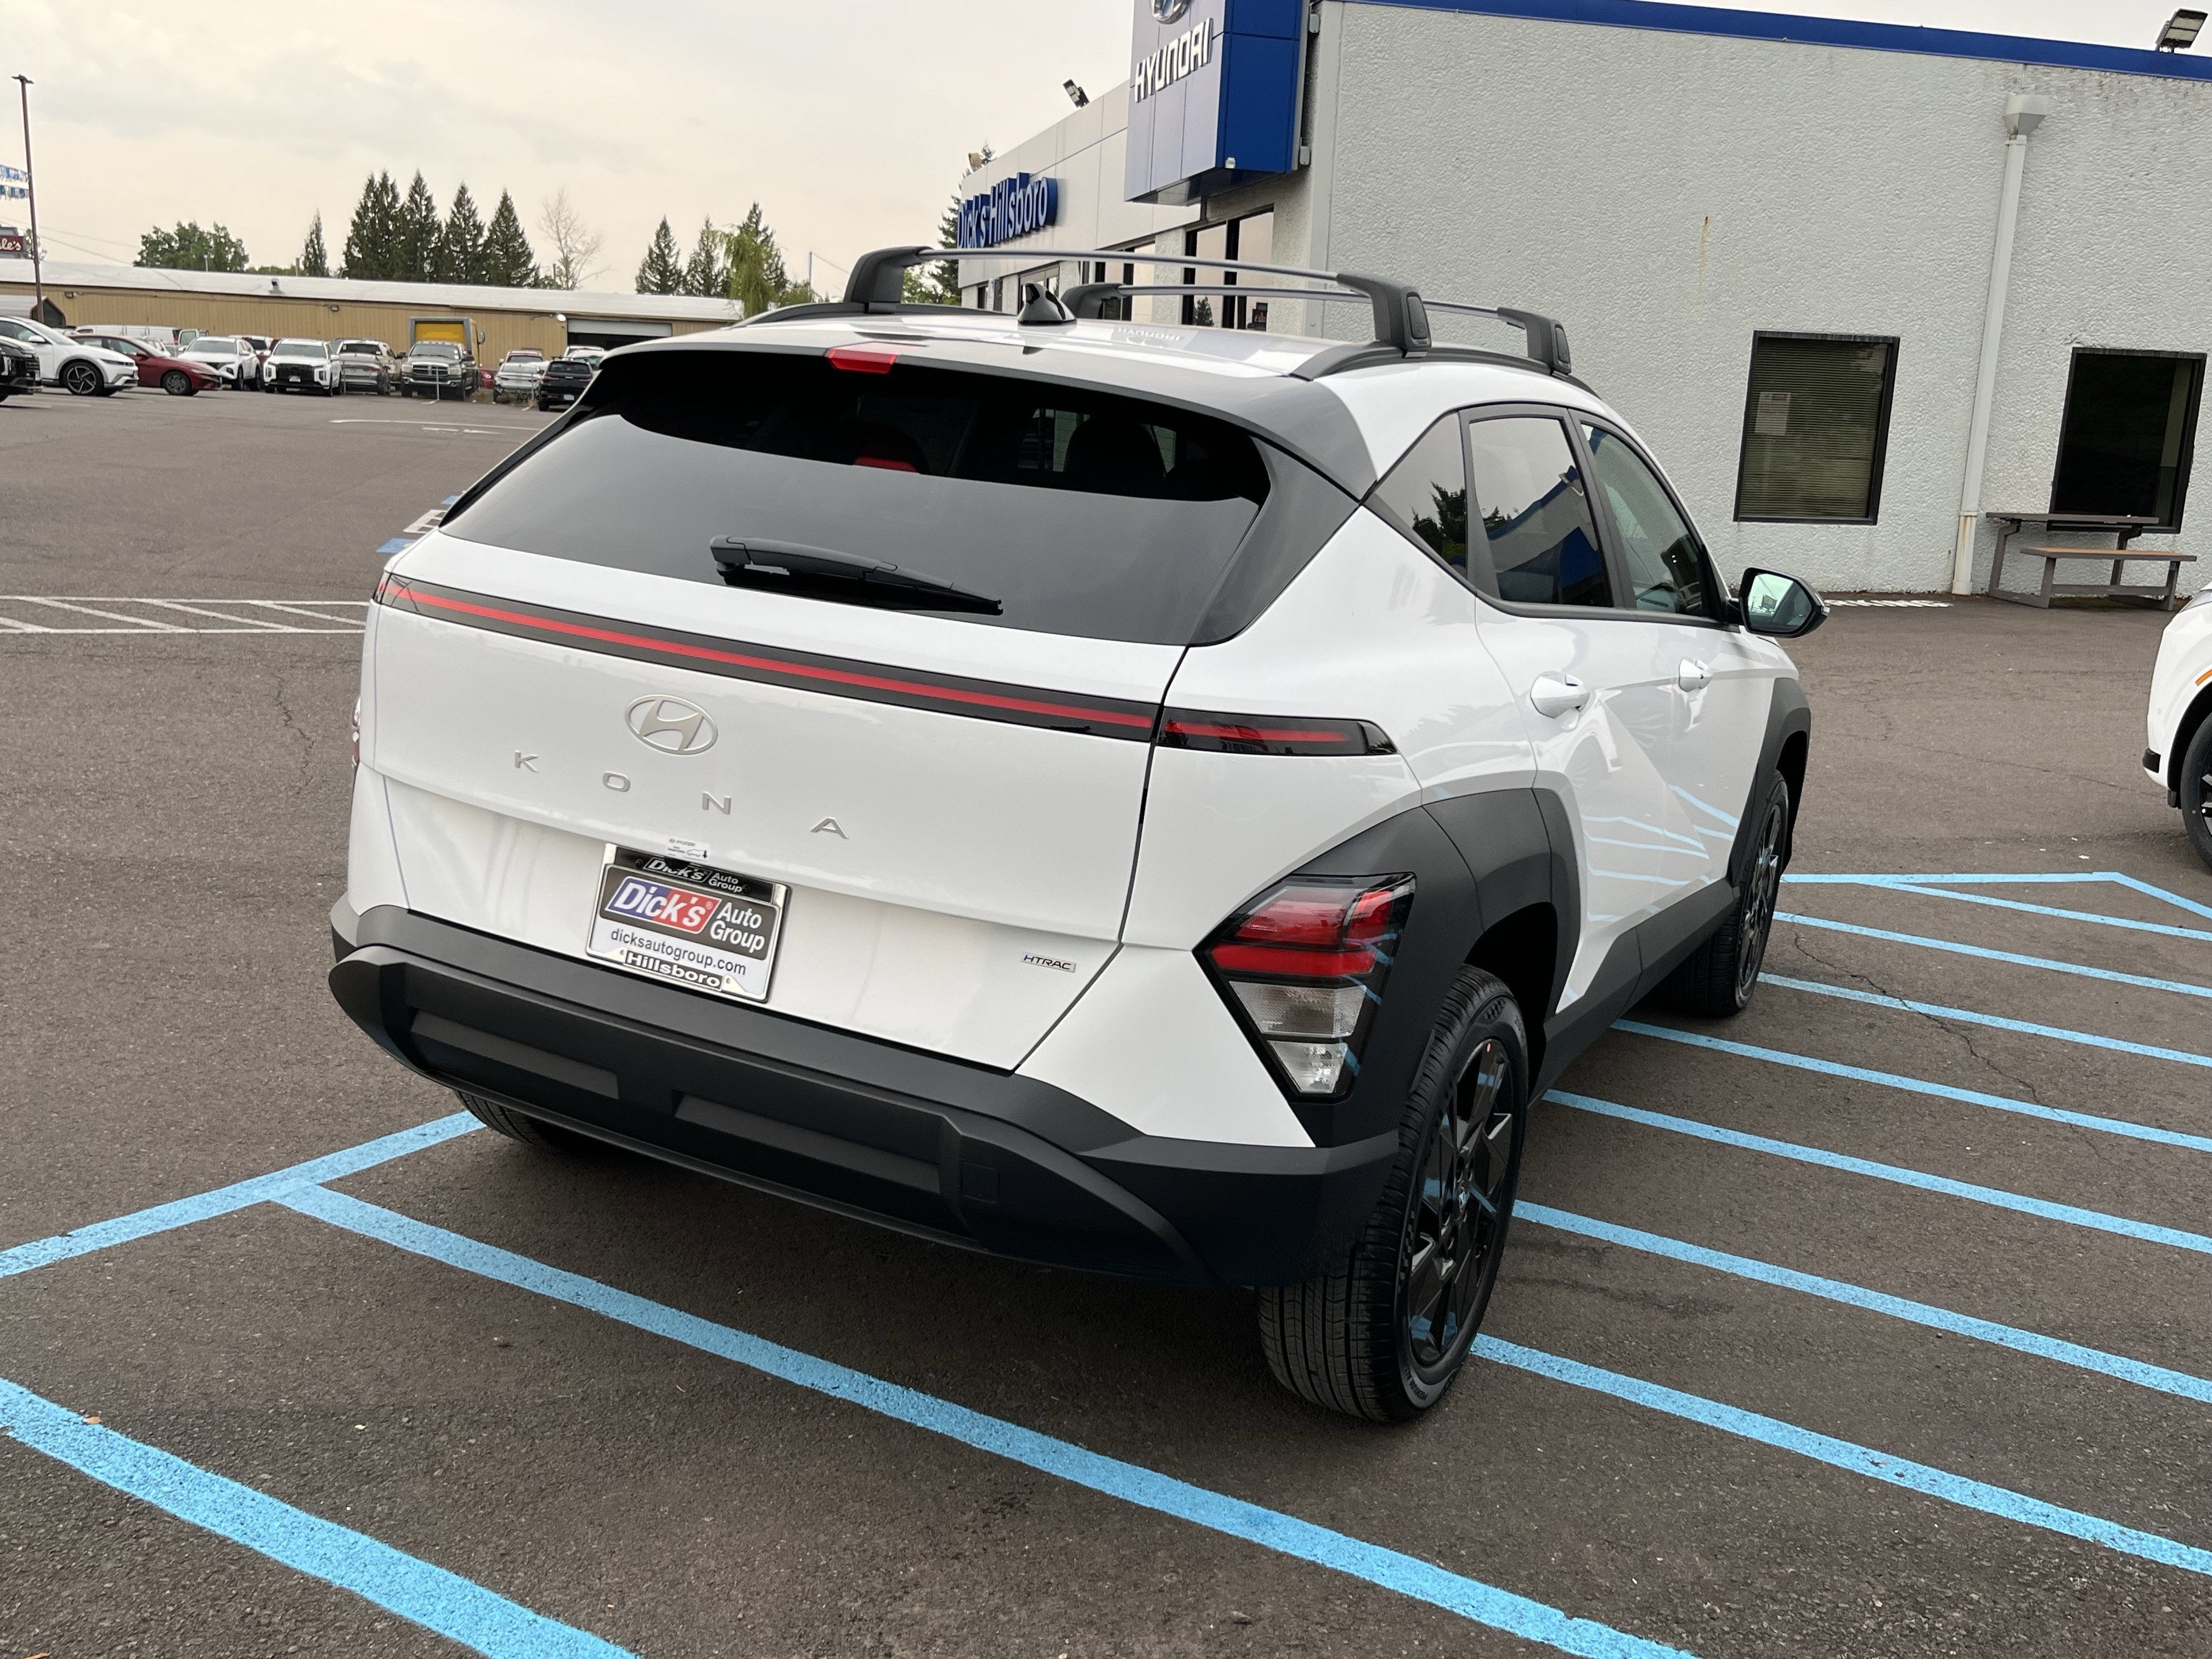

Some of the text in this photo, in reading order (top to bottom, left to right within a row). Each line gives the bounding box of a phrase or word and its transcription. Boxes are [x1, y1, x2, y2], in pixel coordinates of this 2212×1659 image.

[1135, 18, 1211, 103] HYUNDAI
[957, 172, 1049, 249] Dick's Hillsboro
[0, 238, 21, 251] le's
[515, 750, 849, 839] KONA
[708, 879, 742, 894] Group
[713, 872, 739, 885] Auto
[716, 901, 763, 929] Auto
[611, 928, 747, 975] dicksautogroup.com
[709, 919, 765, 953] Group
[627, 951, 721, 988] Hillsboro
[1023, 955, 1071, 970] HTRAC
